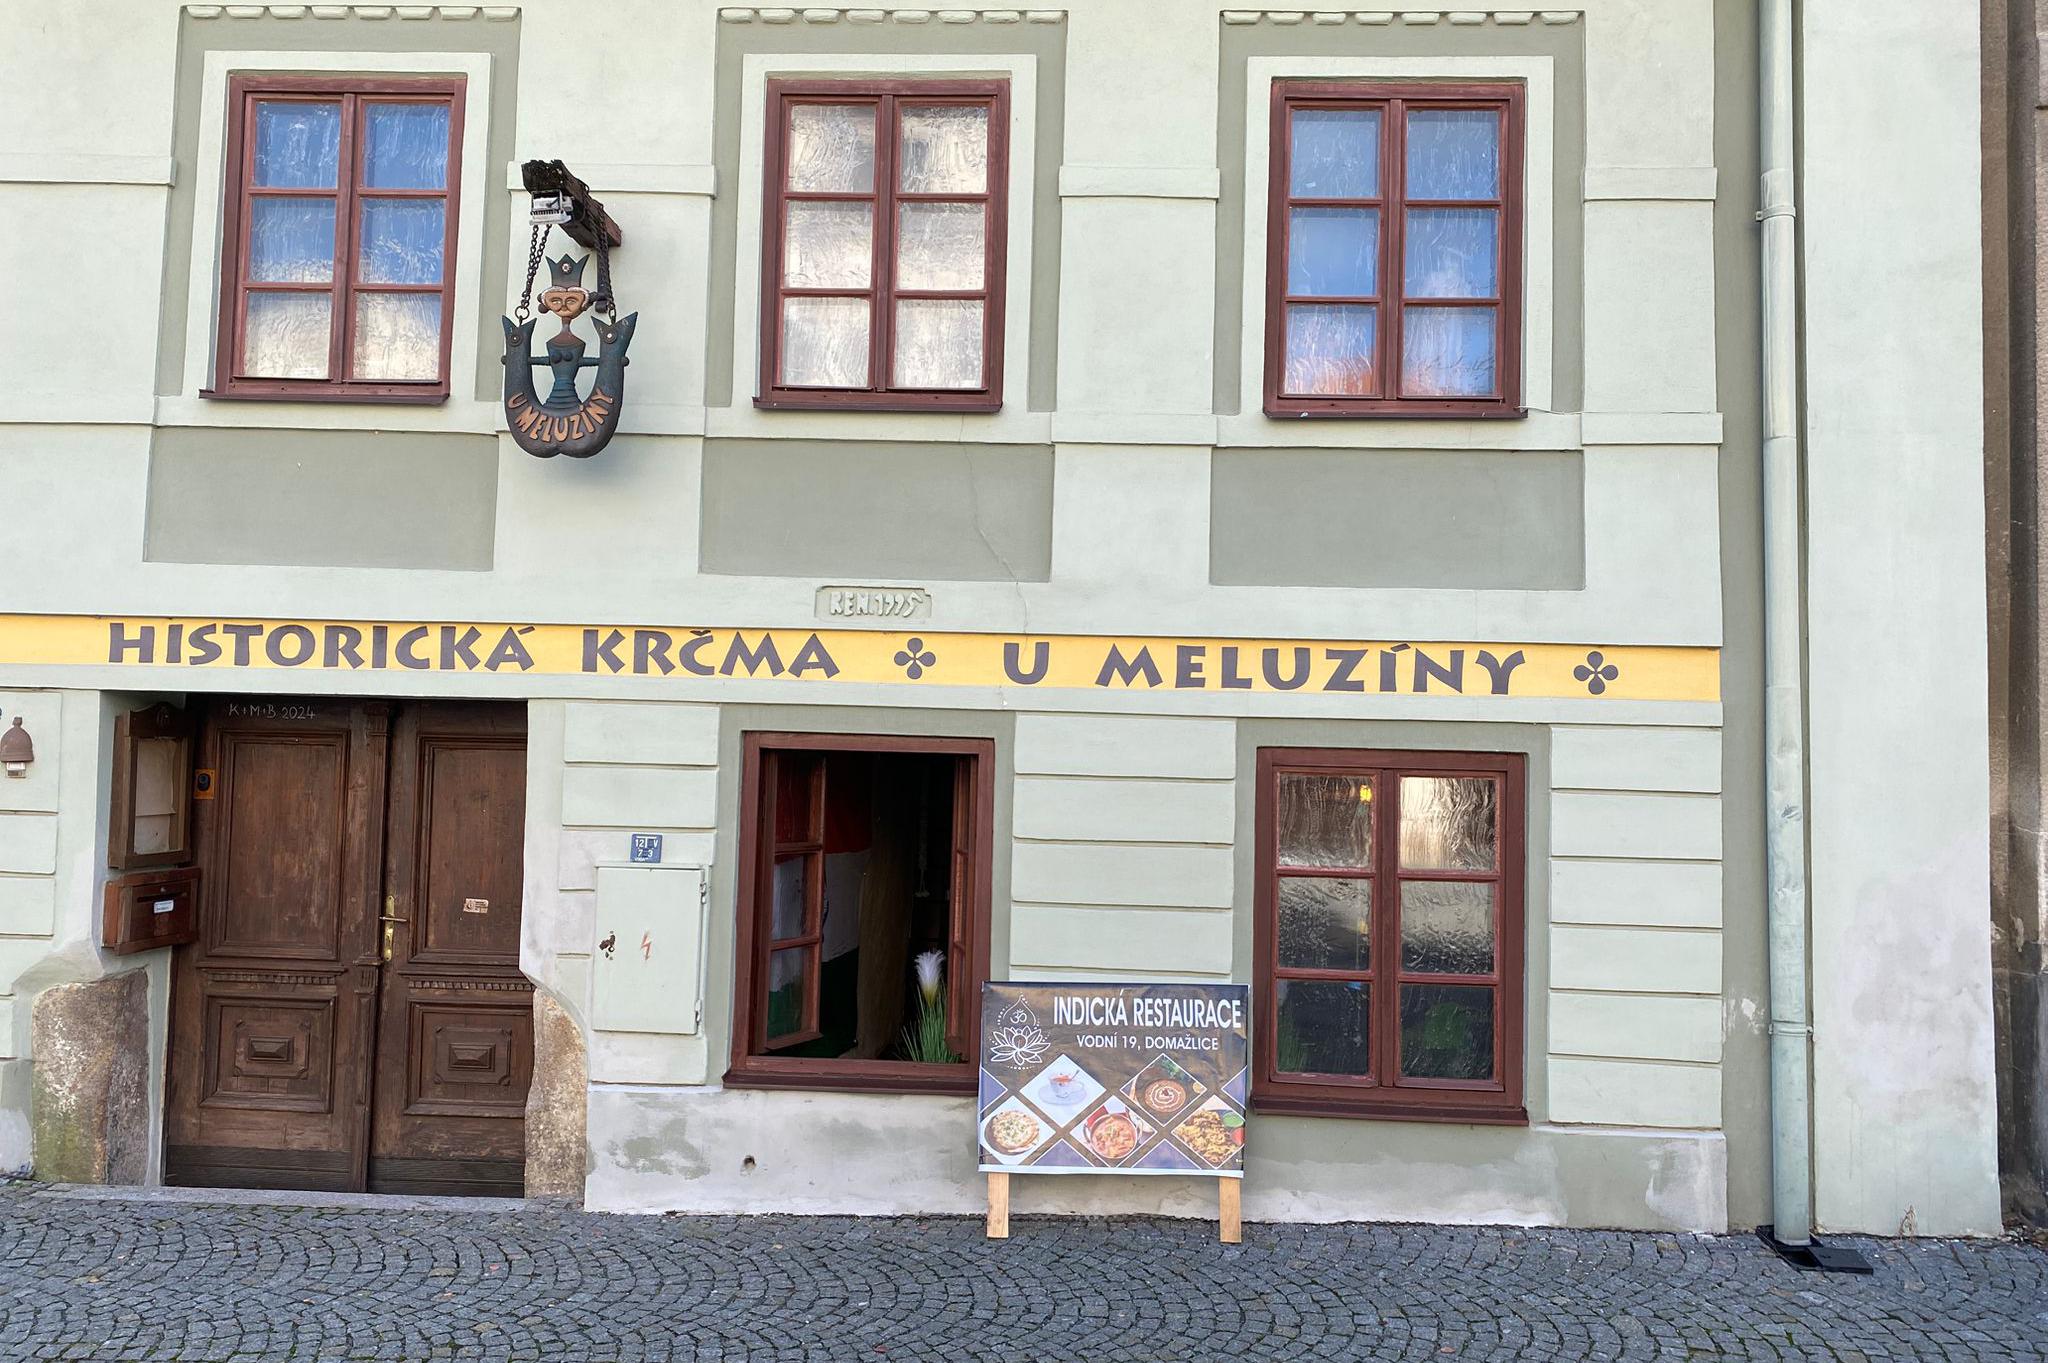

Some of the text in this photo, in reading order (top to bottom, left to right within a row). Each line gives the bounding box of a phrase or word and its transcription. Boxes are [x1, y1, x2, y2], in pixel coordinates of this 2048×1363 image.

[508, 392, 528, 409] U
[875, 592, 923, 618] 1995
[108, 622, 1526, 695] HISTORICKÁ KRČMA U MELUZÍNY
[281, 705, 316, 719] 2024
[1053, 989, 1242, 1029] INDICKÁ RESTAURACE
[1076, 1032, 1219, 1051] VODNÍ 19, DOMAŽLICE
